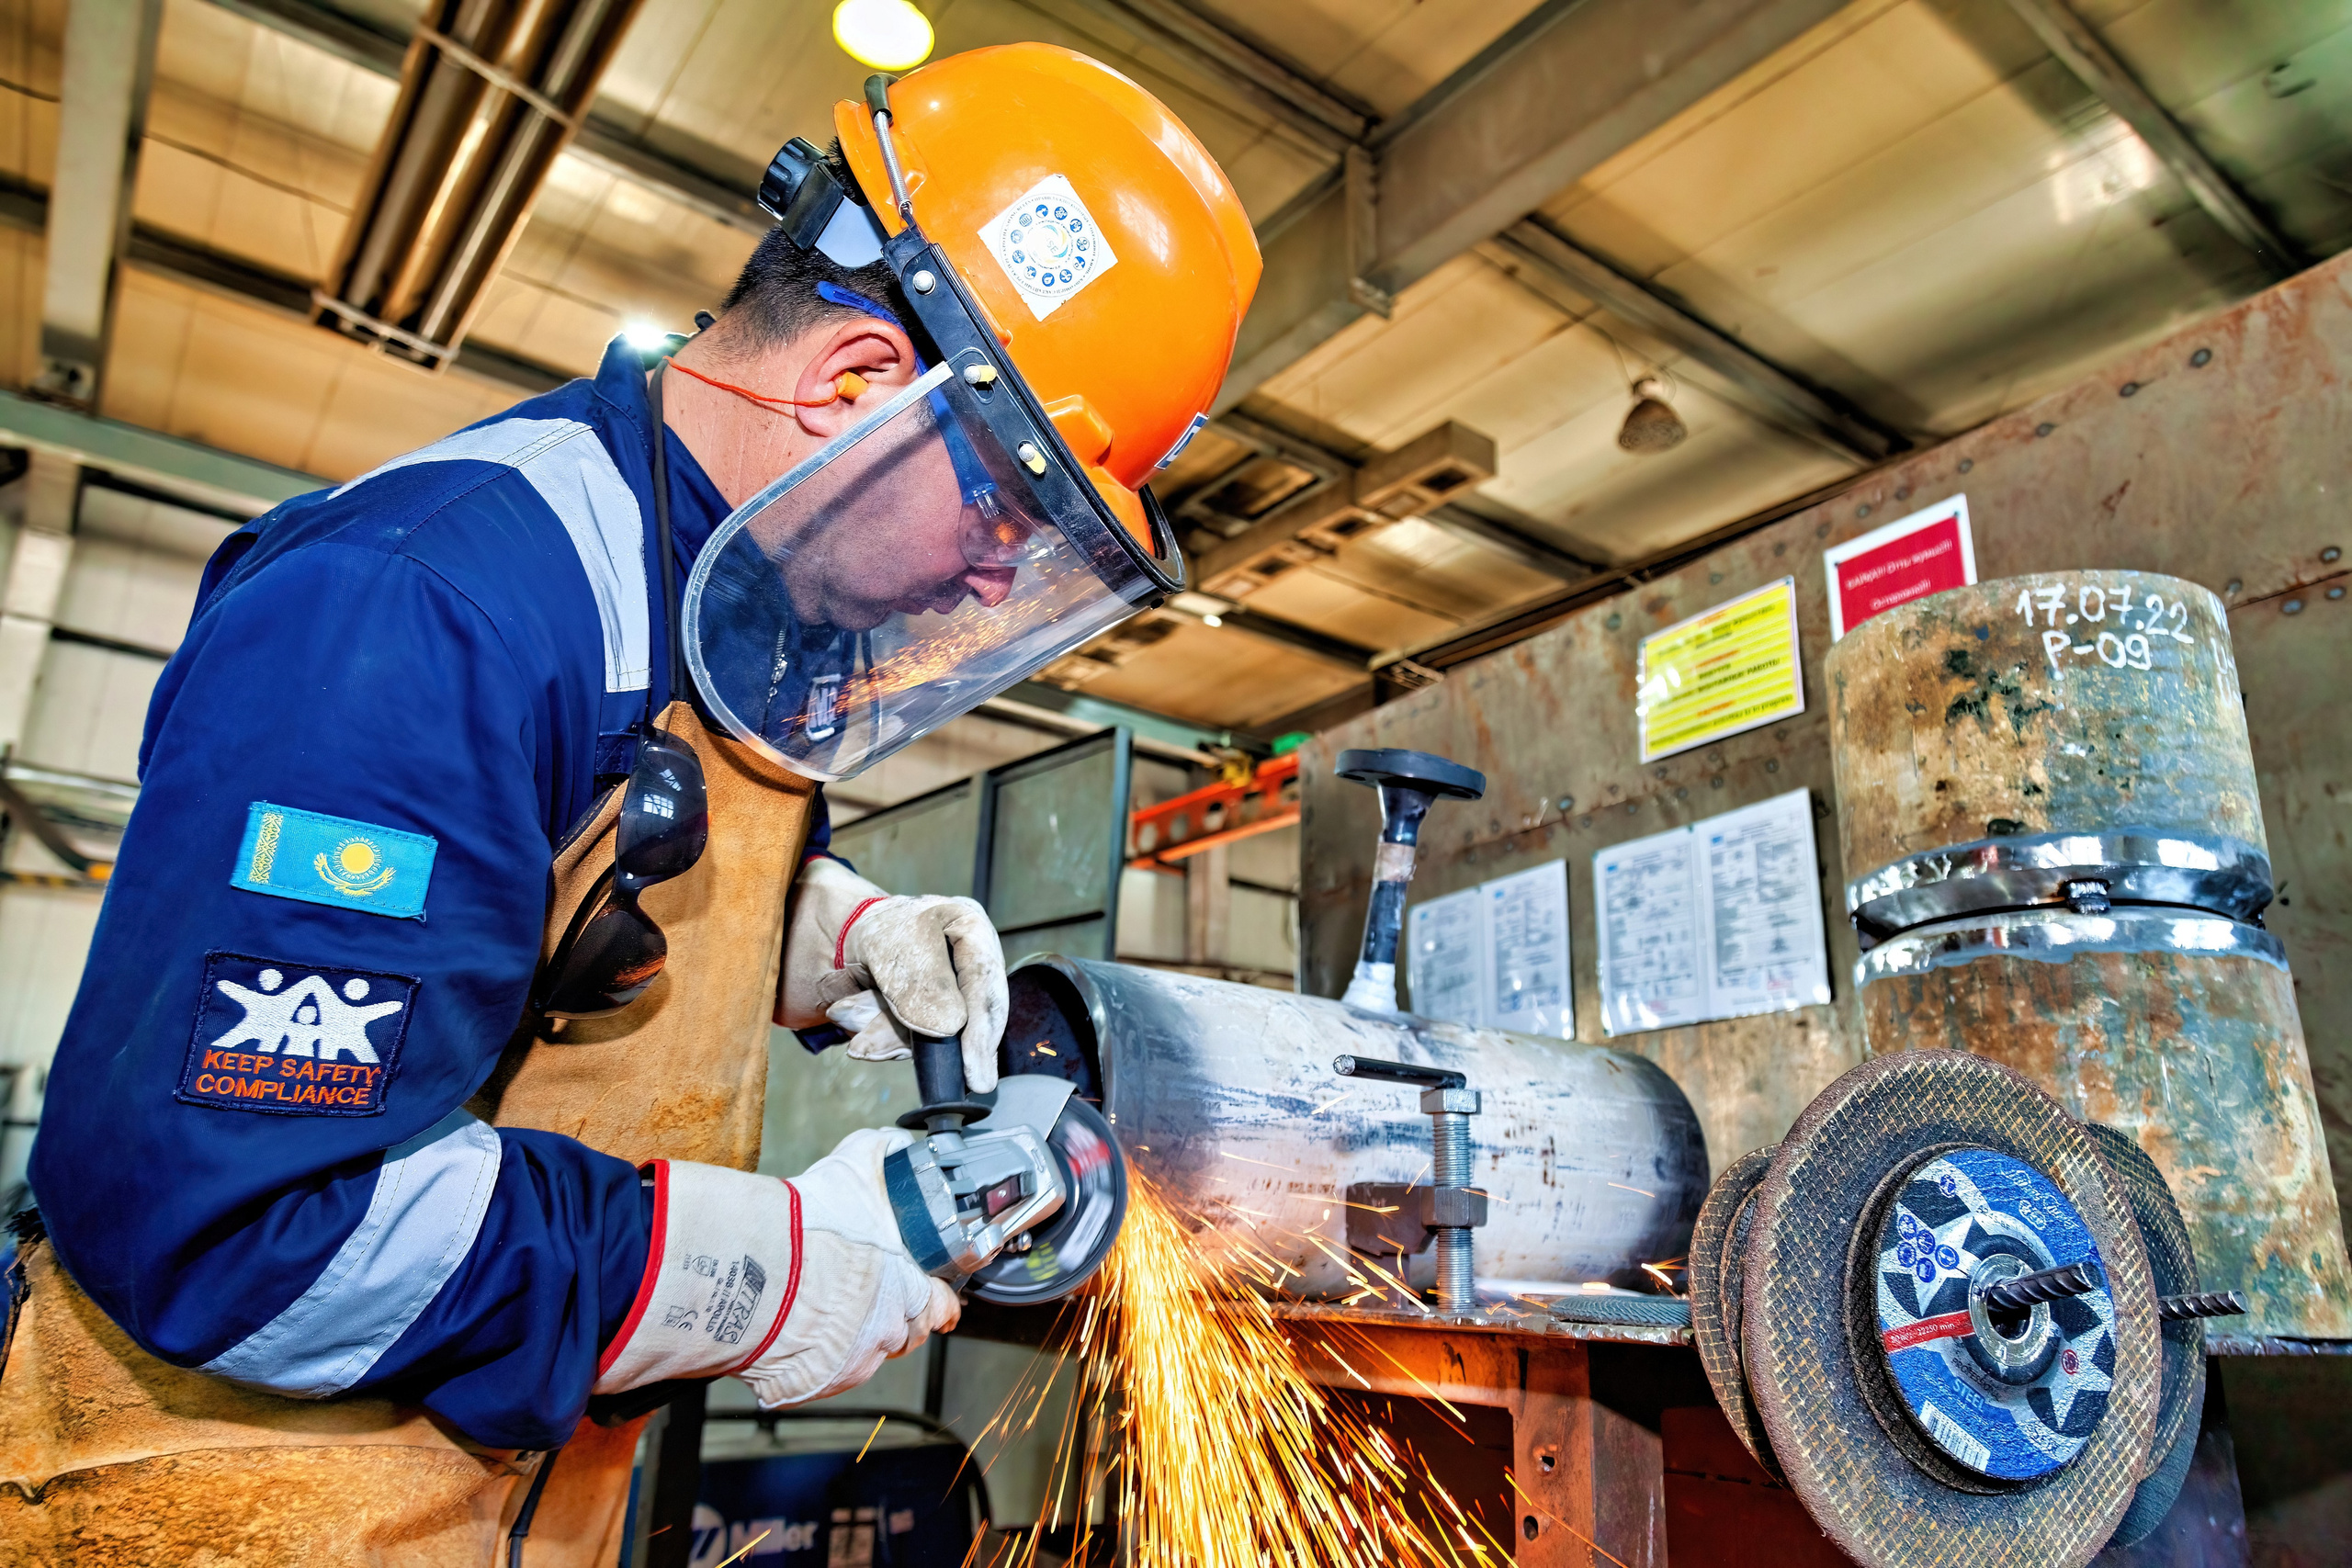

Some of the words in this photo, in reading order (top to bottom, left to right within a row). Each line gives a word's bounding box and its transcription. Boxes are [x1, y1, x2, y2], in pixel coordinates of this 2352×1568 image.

[2015, 582, 2195, 644] 17.07.22
[201, 1049, 274, 1075] KEEP
[278, 1058, 381, 1088] SAFETY
[195, 1073, 373, 1105] COMPLIANCE
[1952, 1379, 1986, 1413] STEEL
